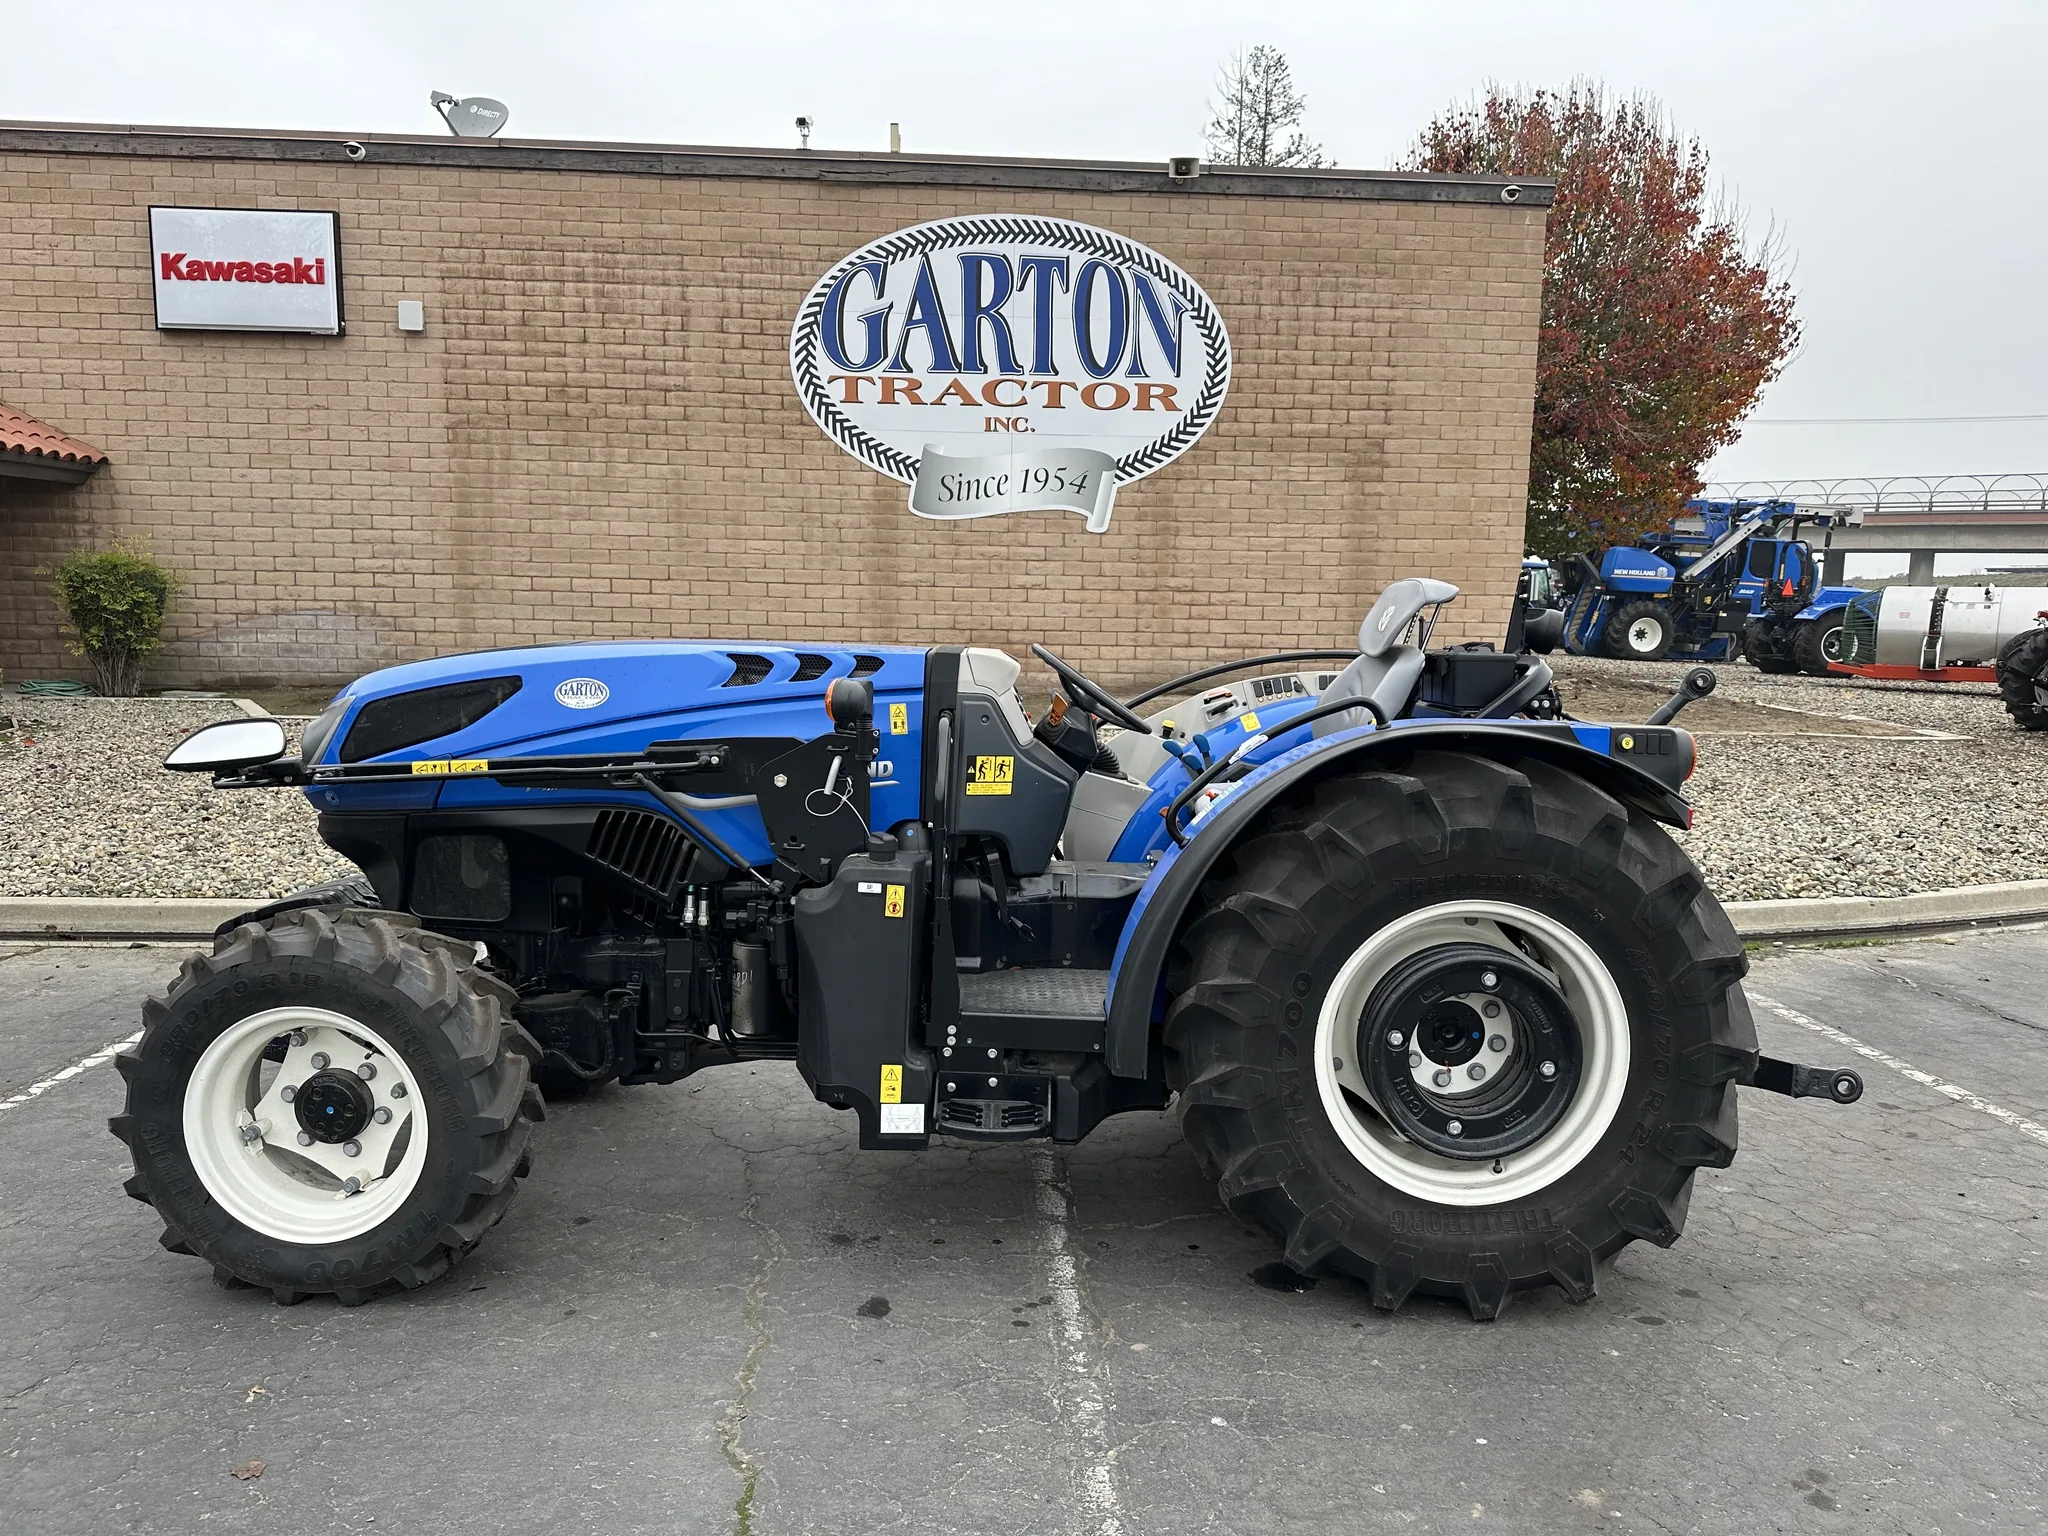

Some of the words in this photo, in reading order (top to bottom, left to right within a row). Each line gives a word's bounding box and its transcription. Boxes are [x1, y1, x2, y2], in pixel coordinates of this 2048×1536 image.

[160, 252, 325, 285] Kawasaki
[820, 252, 1196, 379] GARTON
[827, 375, 1183, 412] TRACTOR
[983, 416, 1036, 433] INC.
[937, 471, 1009, 503] Since
[1020, 466, 1089, 496] 1954
[559, 682, 604, 697] GARTON
[1392, 873, 1566, 900] TRELLEBORG
[259, 972, 280, 990] R
[288, 971, 323, 990] 18
[1642, 1088, 1667, 1115] R
[1616, 1120, 1652, 1166] 24
[1389, 1208, 1560, 1235] TRELLEBORG
